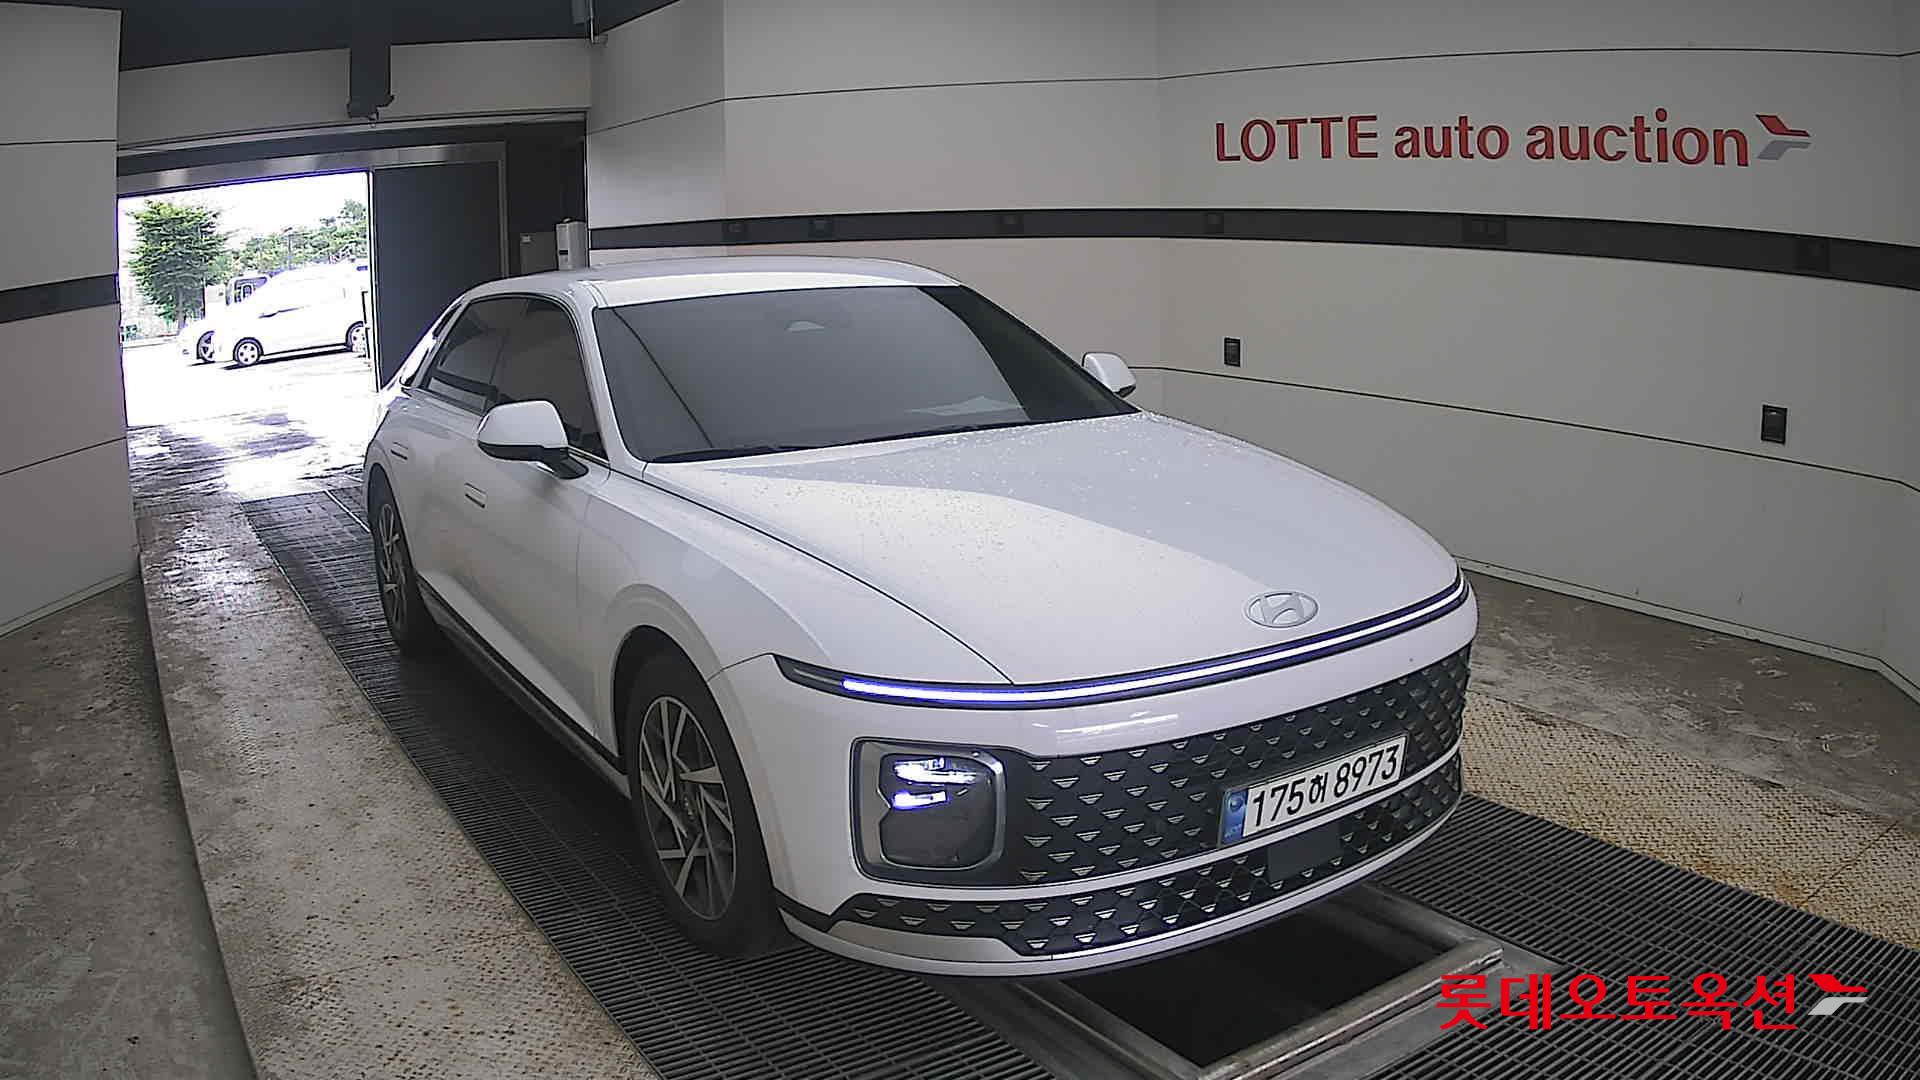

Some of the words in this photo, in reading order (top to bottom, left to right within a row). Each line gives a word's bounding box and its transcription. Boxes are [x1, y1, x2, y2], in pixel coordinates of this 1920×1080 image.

[1216, 115, 1378, 162] LOTTE
[1393, 115, 1510, 160] auto
[1526, 107, 1750, 167] auction
[1253, 772, 1328, 827] 175허
[1334, 744, 1399, 797] 8973
